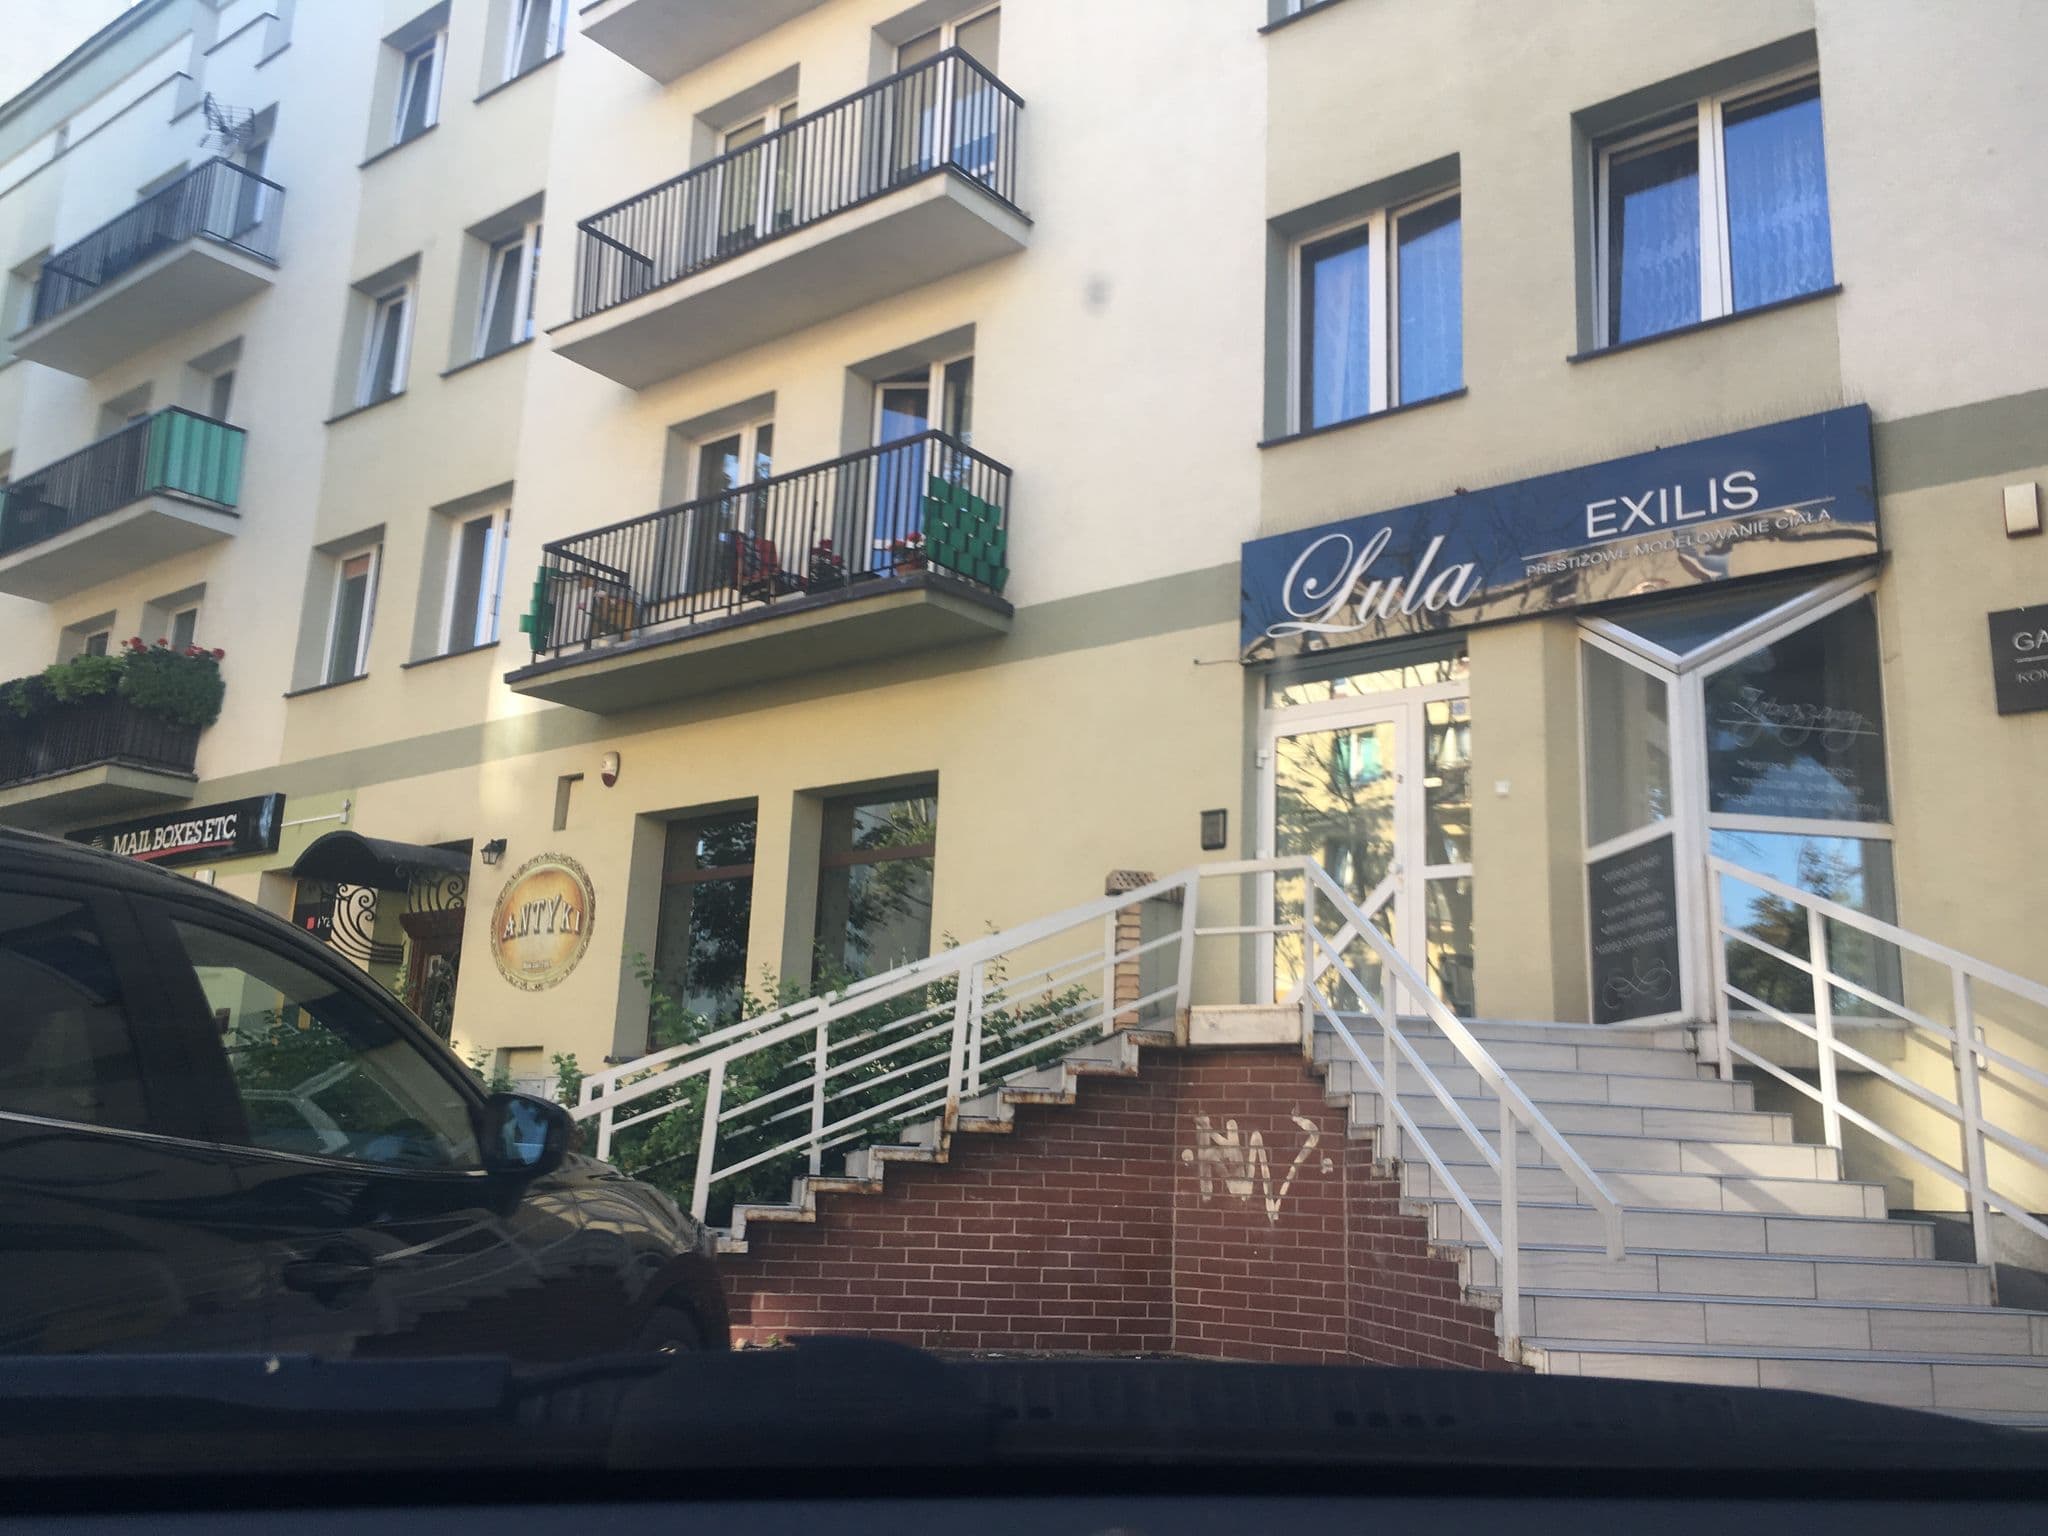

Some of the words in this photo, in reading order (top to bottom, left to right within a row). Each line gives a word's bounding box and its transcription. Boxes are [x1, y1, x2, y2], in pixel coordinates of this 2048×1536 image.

[1586, 470, 1760, 539] EXILIS
[1635, 518, 1770, 556] MODELOWANIE
[1775, 507, 1832, 530] CIAŁA
[1266, 526, 1483, 639] Lula
[112, 831, 152, 857] MAIL
[152, 821, 203, 850] BOXES
[202, 813, 238, 842] ETC.
[502, 893, 583, 943] ANTYKI
